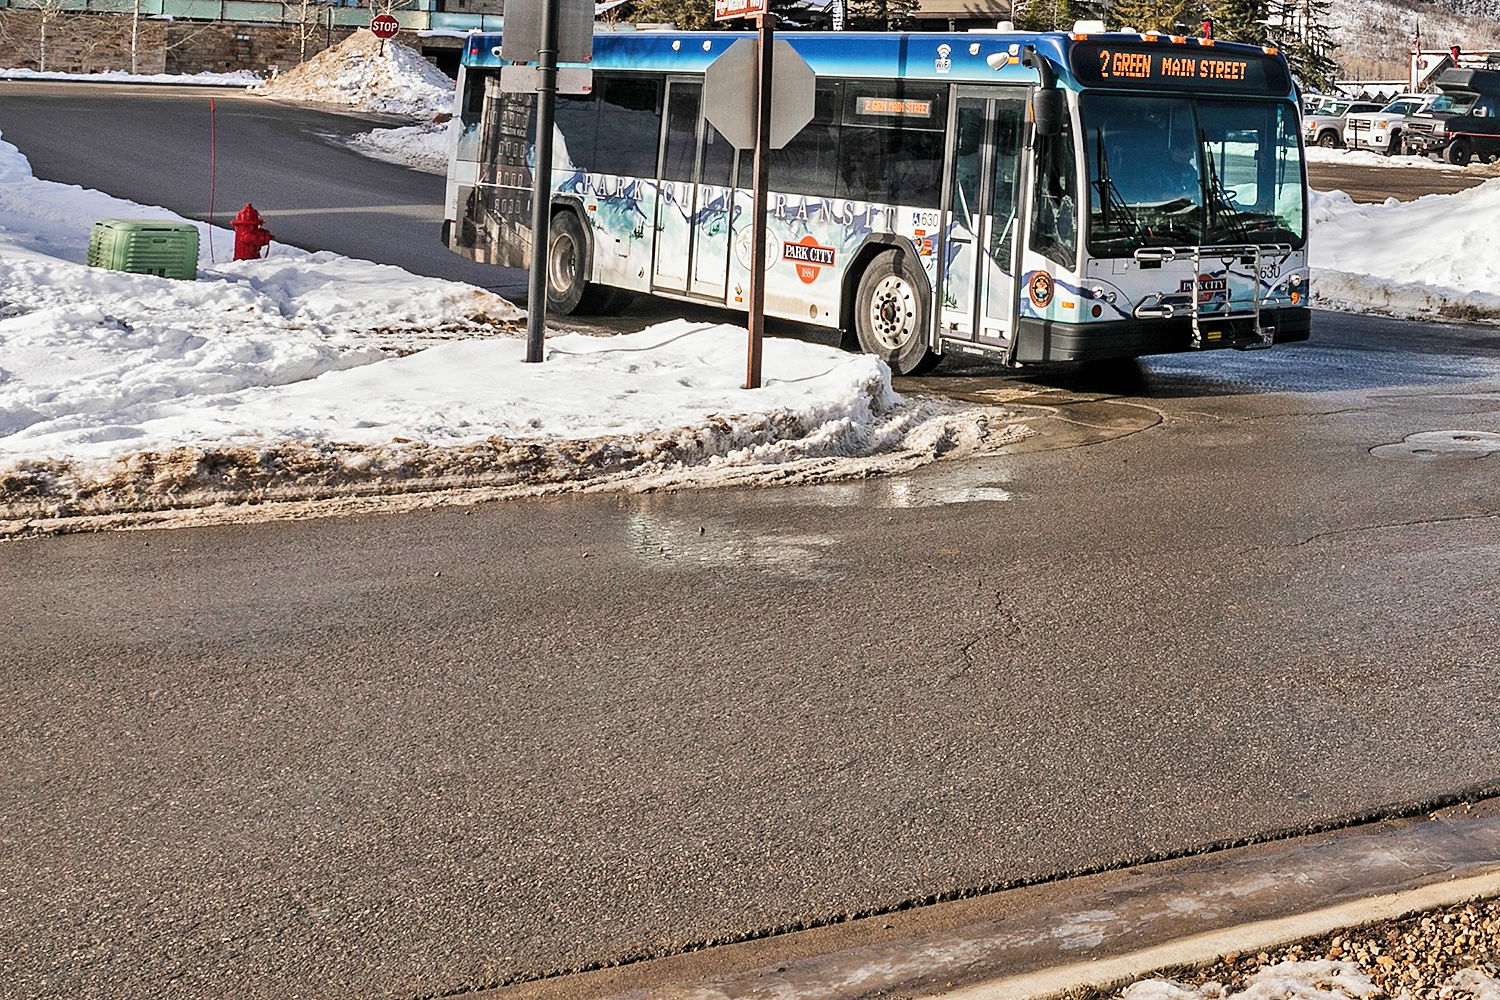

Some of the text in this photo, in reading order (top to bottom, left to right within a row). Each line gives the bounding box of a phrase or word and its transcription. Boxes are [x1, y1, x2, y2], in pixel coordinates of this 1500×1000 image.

[372, 21, 398, 32] STOP
[1099, 50, 1247, 80] 2 GREEN MAIN STREET
[864, 99, 871, 111] 2
[888, 101, 904, 114] MAIN
[905, 101, 930, 115] STREET
[583, 173, 898, 231] PARK CITY RANSIT
[921, 212, 939, 227] 630
[784, 244, 809, 261] PARK
[809, 248, 834, 265] CITY
[801, 267, 815, 279] 1884
[1260, 266, 1280, 279] 630
[1183, 280, 1225, 291] PAK CITY
